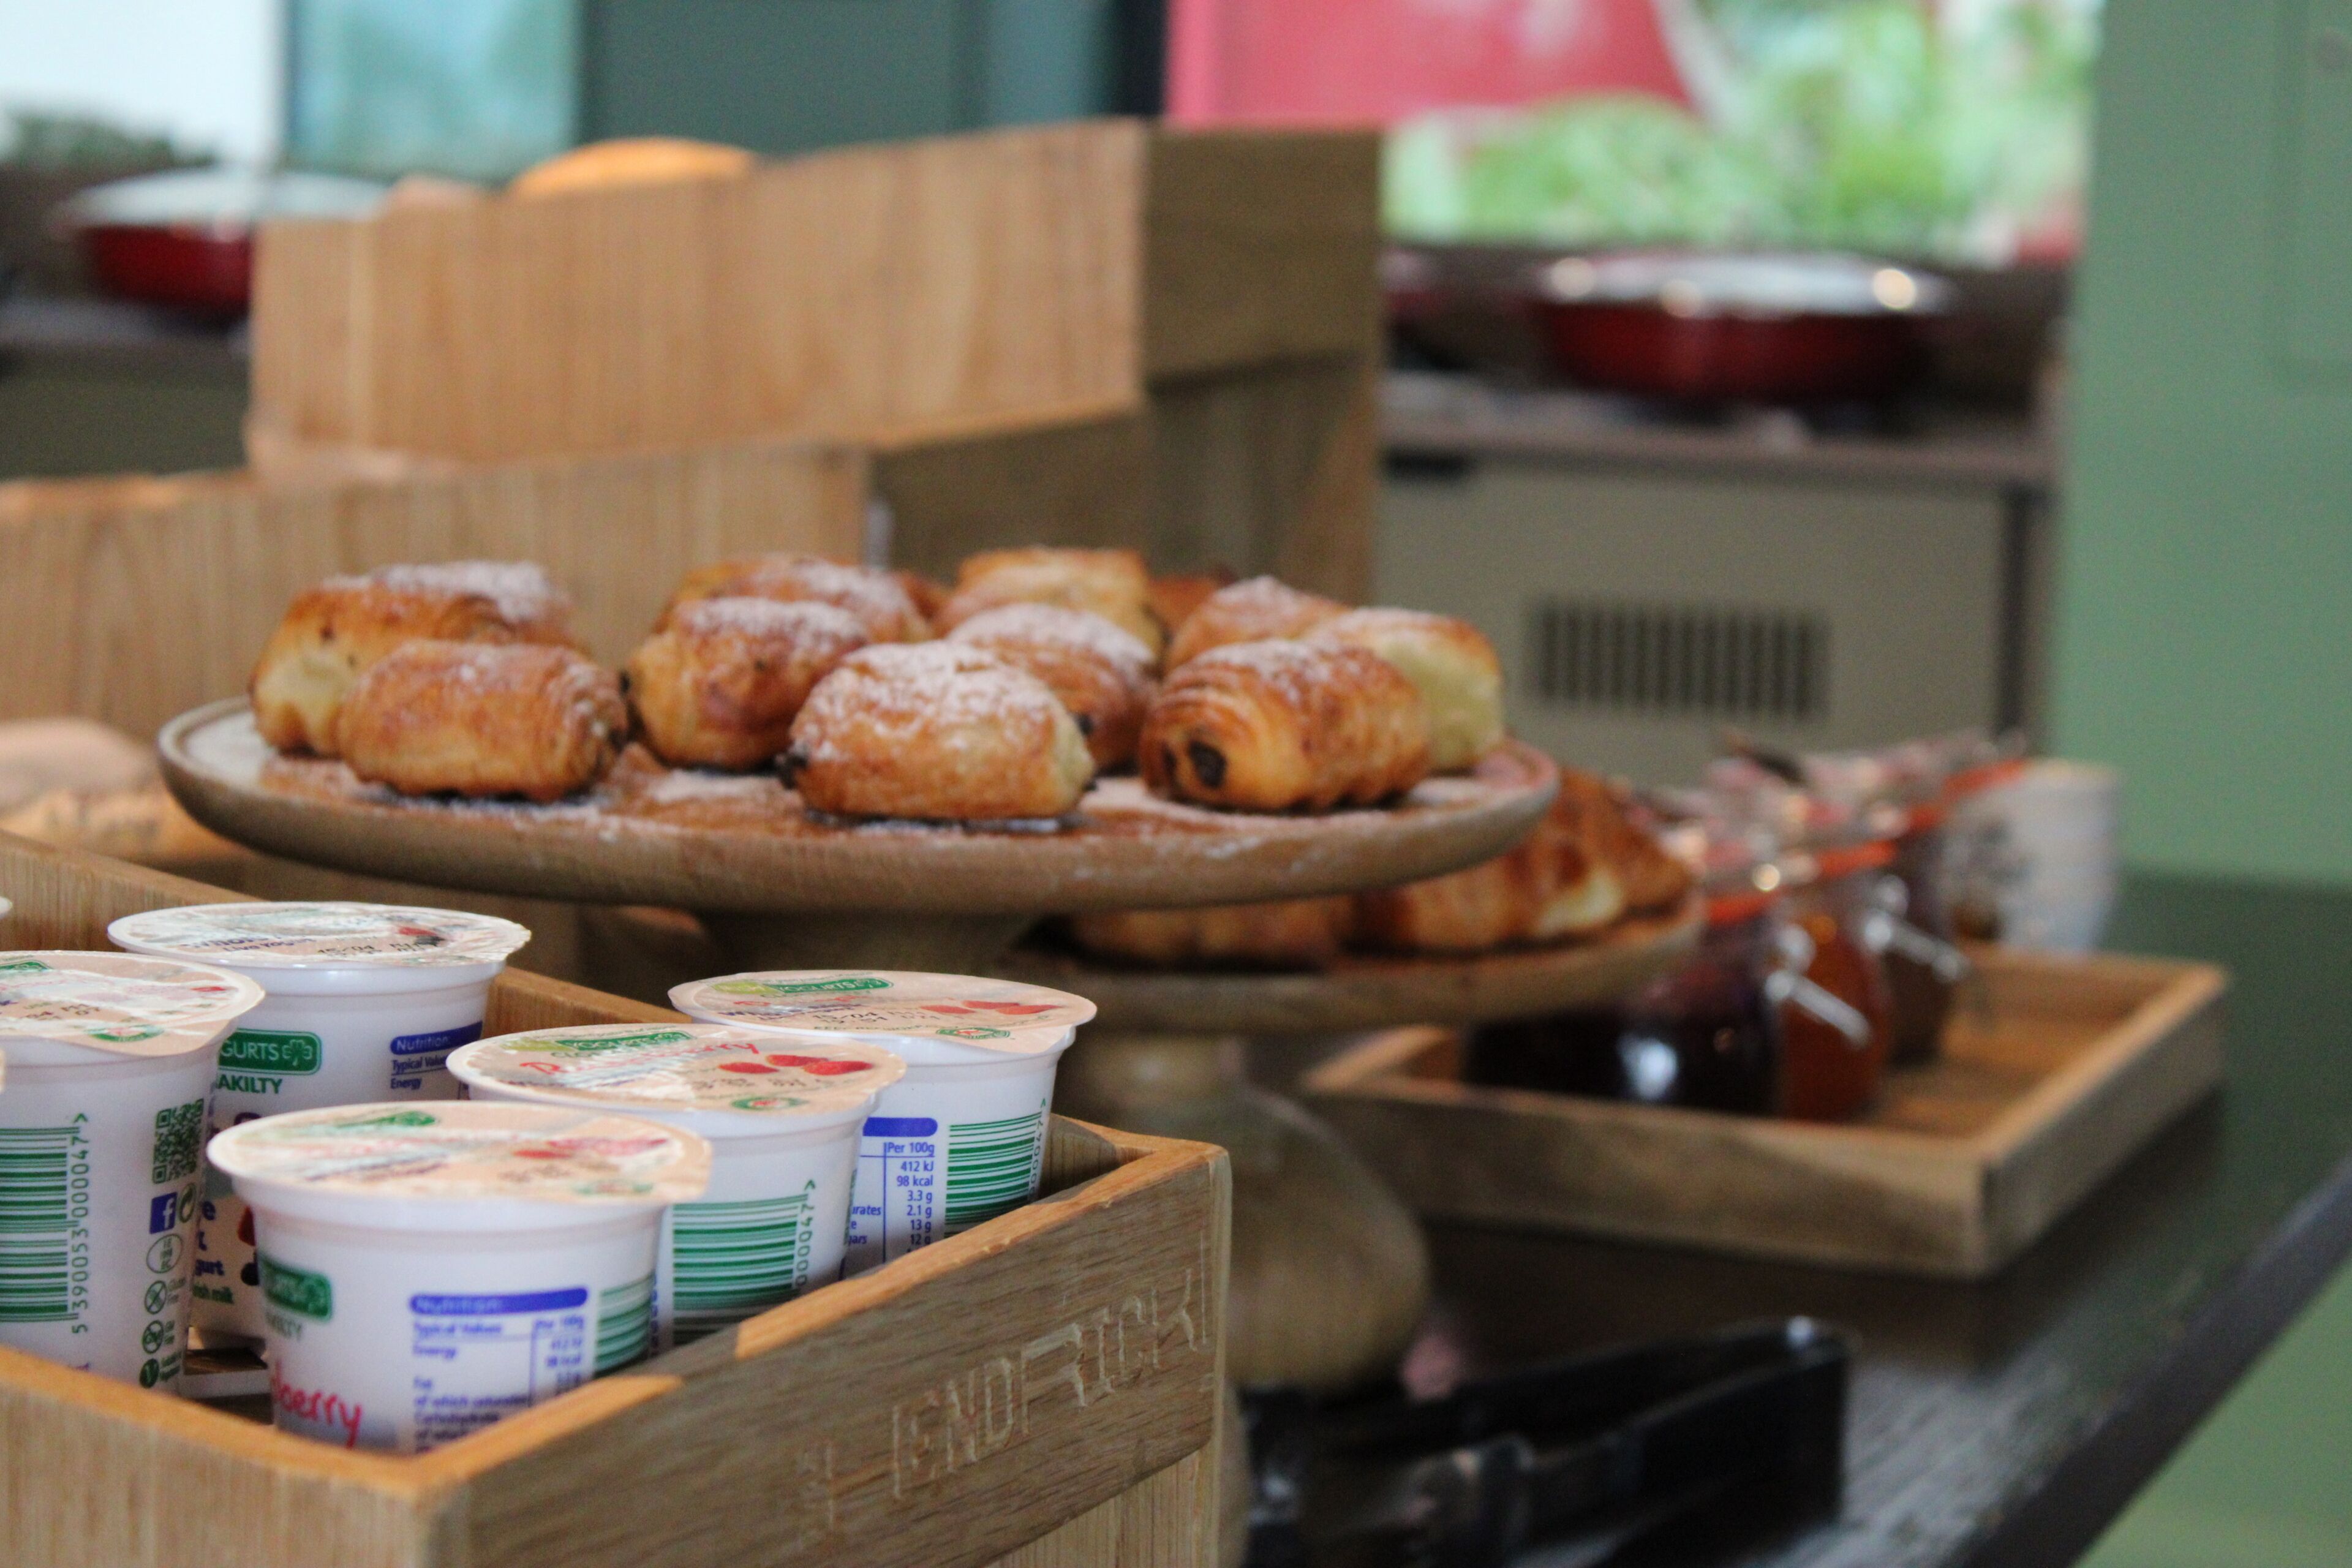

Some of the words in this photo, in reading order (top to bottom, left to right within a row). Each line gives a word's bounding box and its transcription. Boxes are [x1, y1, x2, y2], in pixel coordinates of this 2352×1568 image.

[888, 1142, 905, 1153] Per
[910, 1142, 935, 1156] 100g
[900, 1161, 920, 1172] 412
[922, 1161, 934, 1172] kJ
[896, 1176, 910, 1187] 98
[913, 1175, 933, 1186] kcal
[907, 1190, 923, 1202] 3.3
[925, 1192, 933, 1204] g
[907, 1204, 921, 1216] 2.1
[925, 1207, 932, 1219] g
[910, 1219, 922, 1231] 13
[924, 1221, 932, 1234] g
[910, 1234, 921, 1245] 12
